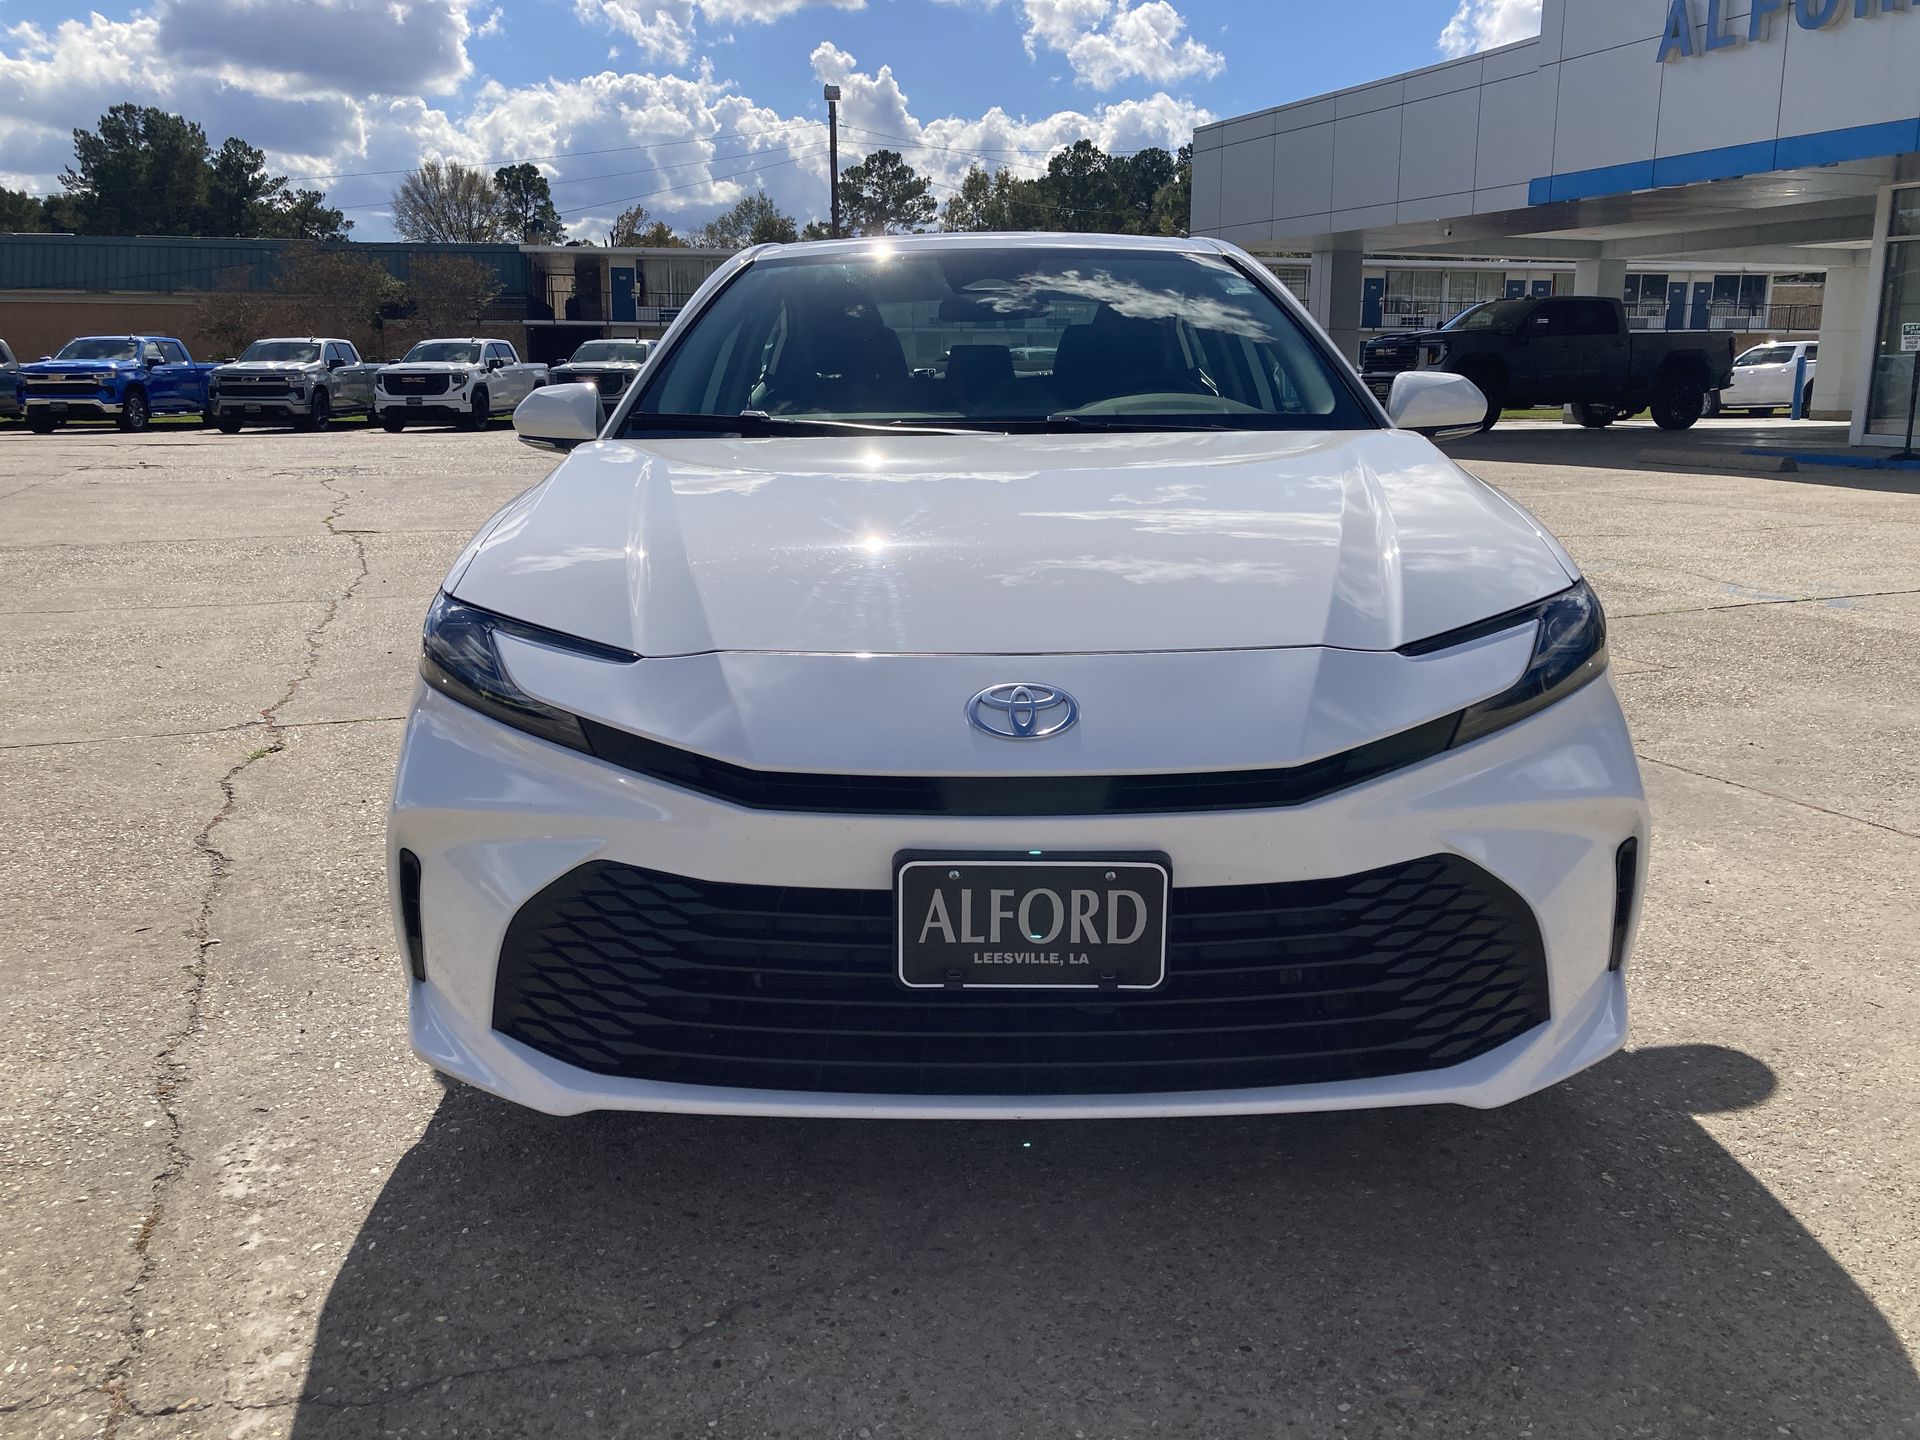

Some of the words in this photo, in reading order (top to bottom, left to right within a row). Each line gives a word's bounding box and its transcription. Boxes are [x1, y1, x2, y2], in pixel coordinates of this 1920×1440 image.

[1656, 0, 1920, 63] ALF
[919, 888, 1147, 944] ALFORD
[974, 952, 1064, 966] LEESVILLE,
[1069, 953, 1089, 965] LA
